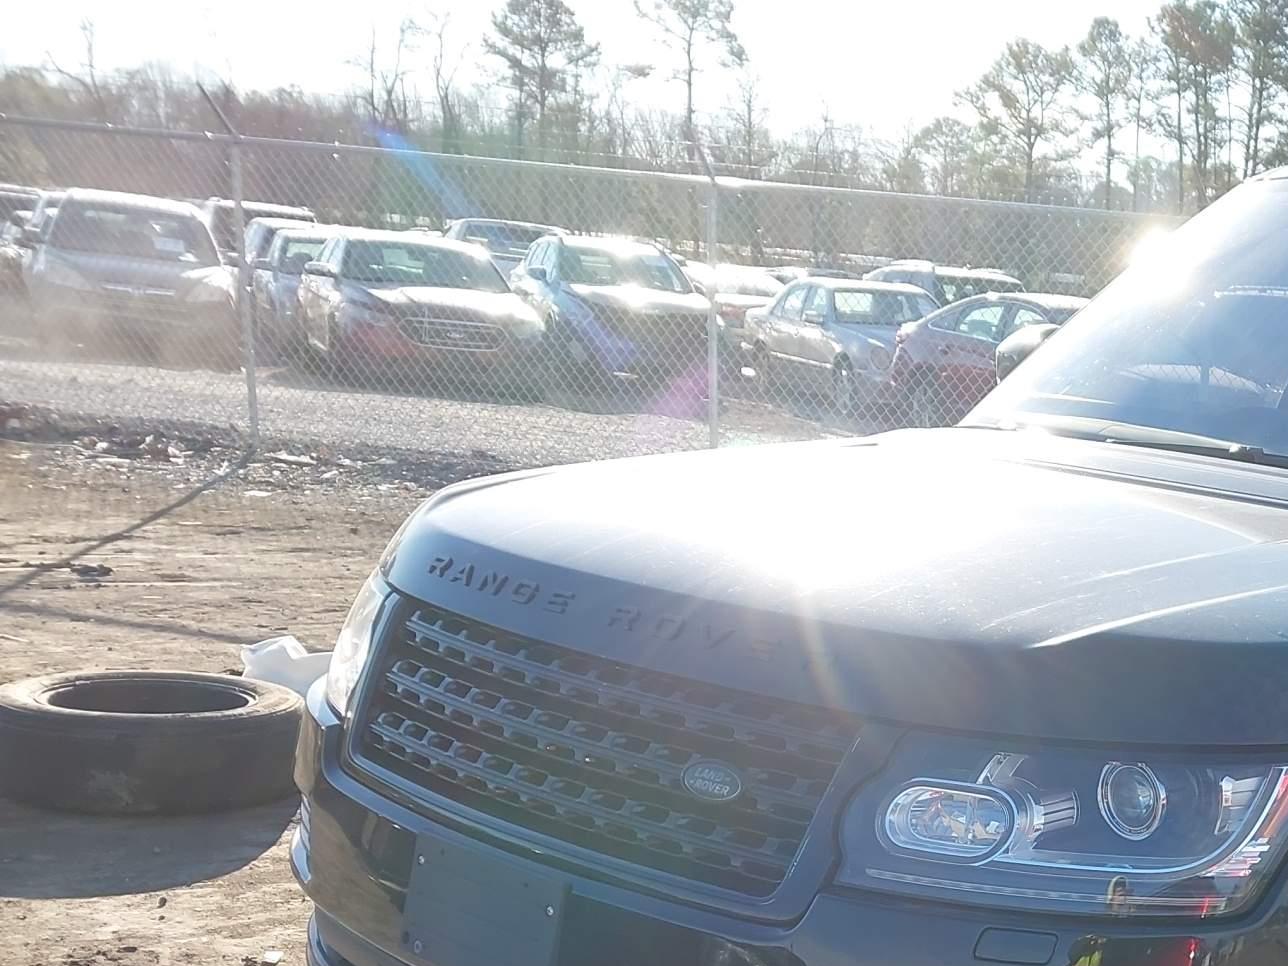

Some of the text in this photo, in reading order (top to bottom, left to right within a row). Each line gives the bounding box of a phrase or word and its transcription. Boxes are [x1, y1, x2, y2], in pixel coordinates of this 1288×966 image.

[426, 556, 800, 666] RANGE ROVE
[695, 778, 730, 797] ROVER
